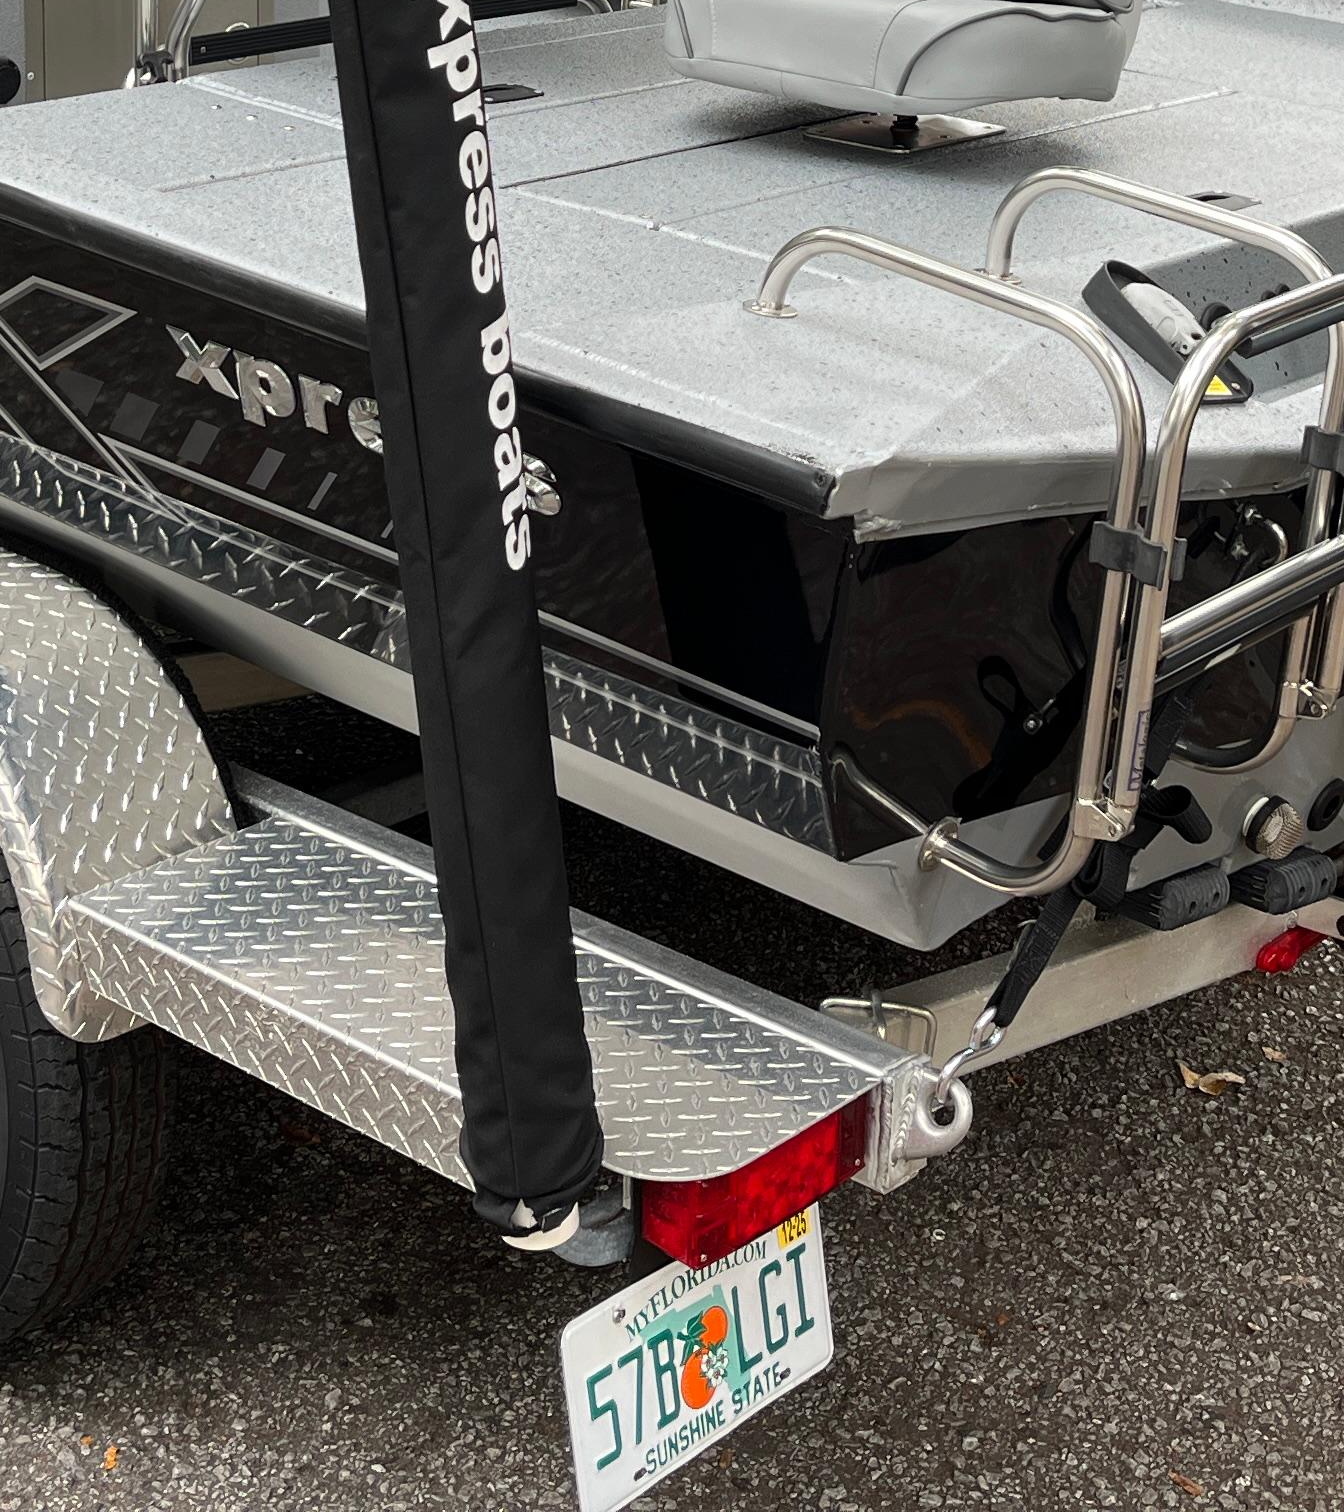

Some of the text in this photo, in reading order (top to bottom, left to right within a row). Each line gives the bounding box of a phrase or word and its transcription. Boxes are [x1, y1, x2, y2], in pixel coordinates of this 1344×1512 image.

[480, 306, 532, 571] boats
[586, 1243, 815, 1470] 57B LGI
[645, 1361, 782, 1475] SUNSHINE STATE
